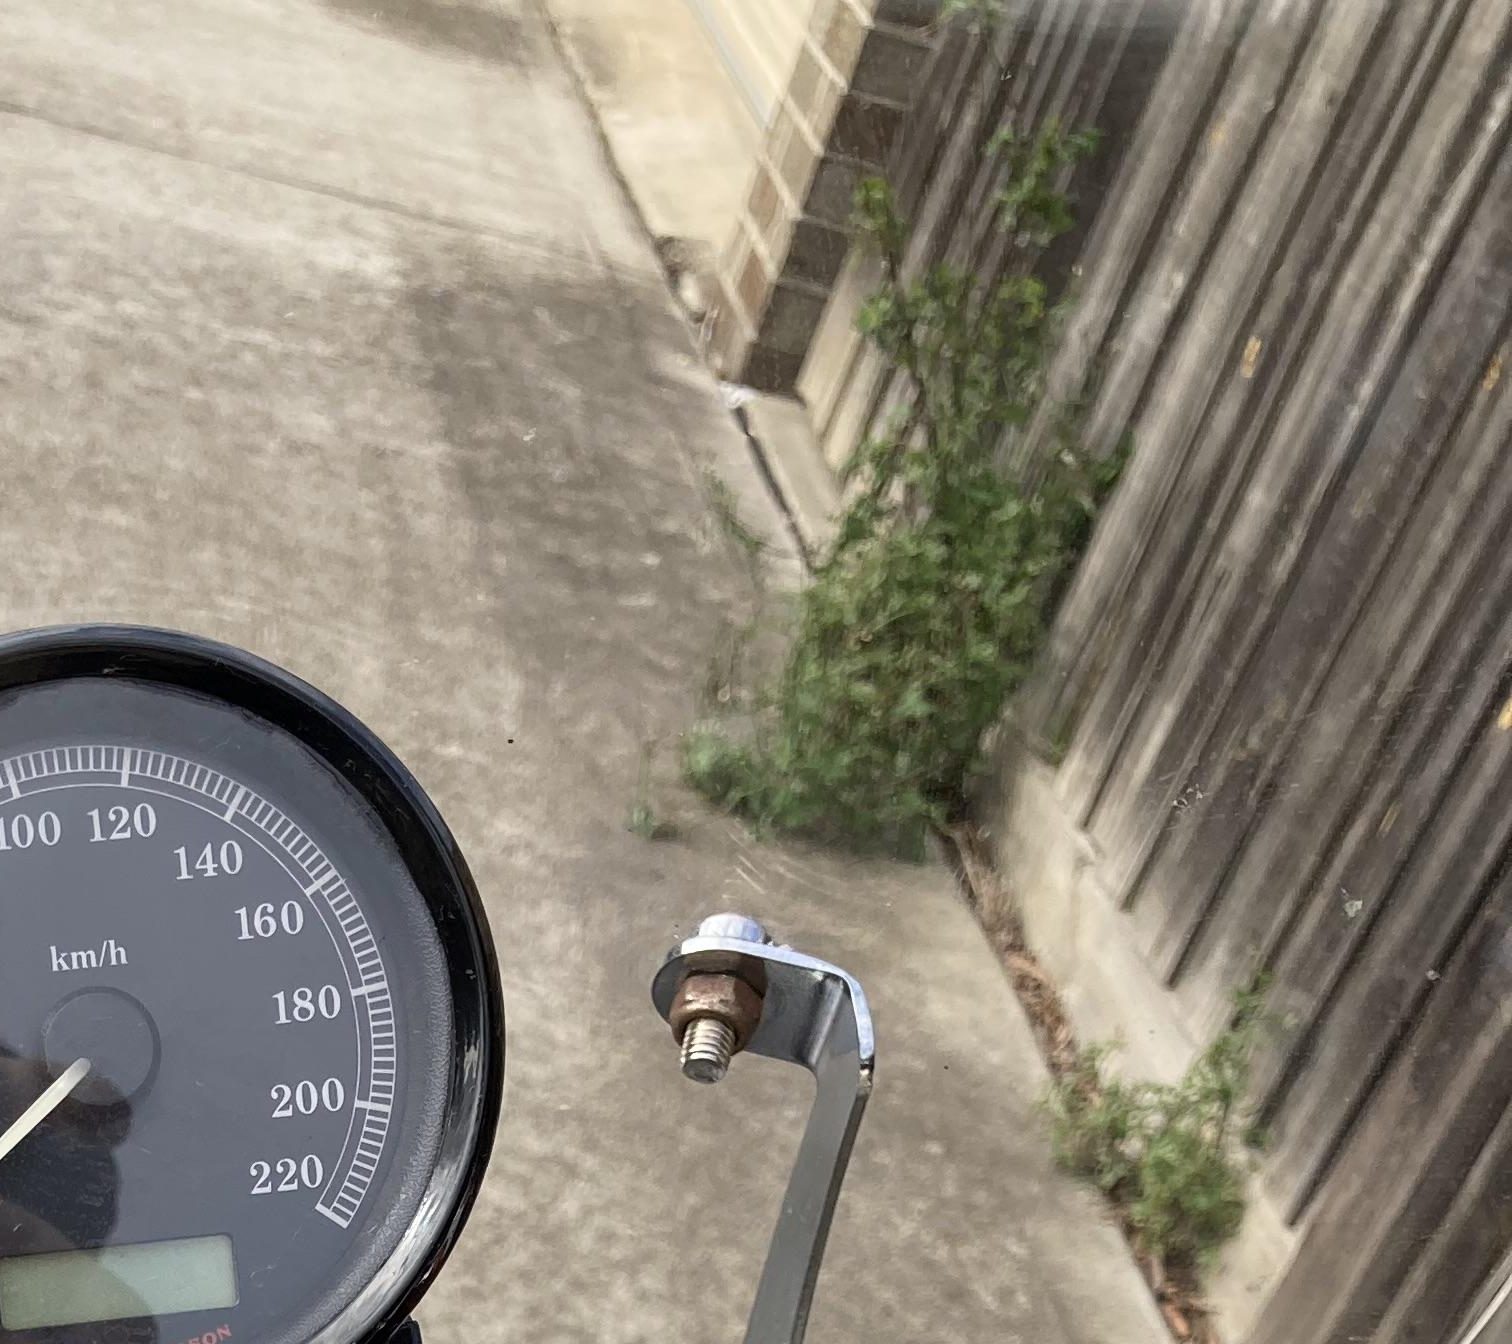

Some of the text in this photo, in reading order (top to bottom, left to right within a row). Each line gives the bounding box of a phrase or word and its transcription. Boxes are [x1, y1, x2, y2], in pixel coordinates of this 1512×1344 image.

[86, 803, 157, 842] 120
[173, 840, 243, 880] 140
[234, 900, 304, 940] 160
[49, 939, 128, 972] km/h
[272, 984, 341, 1025] 180
[270, 1077, 345, 1119] 200
[249, 1154, 324, 1195] 220
